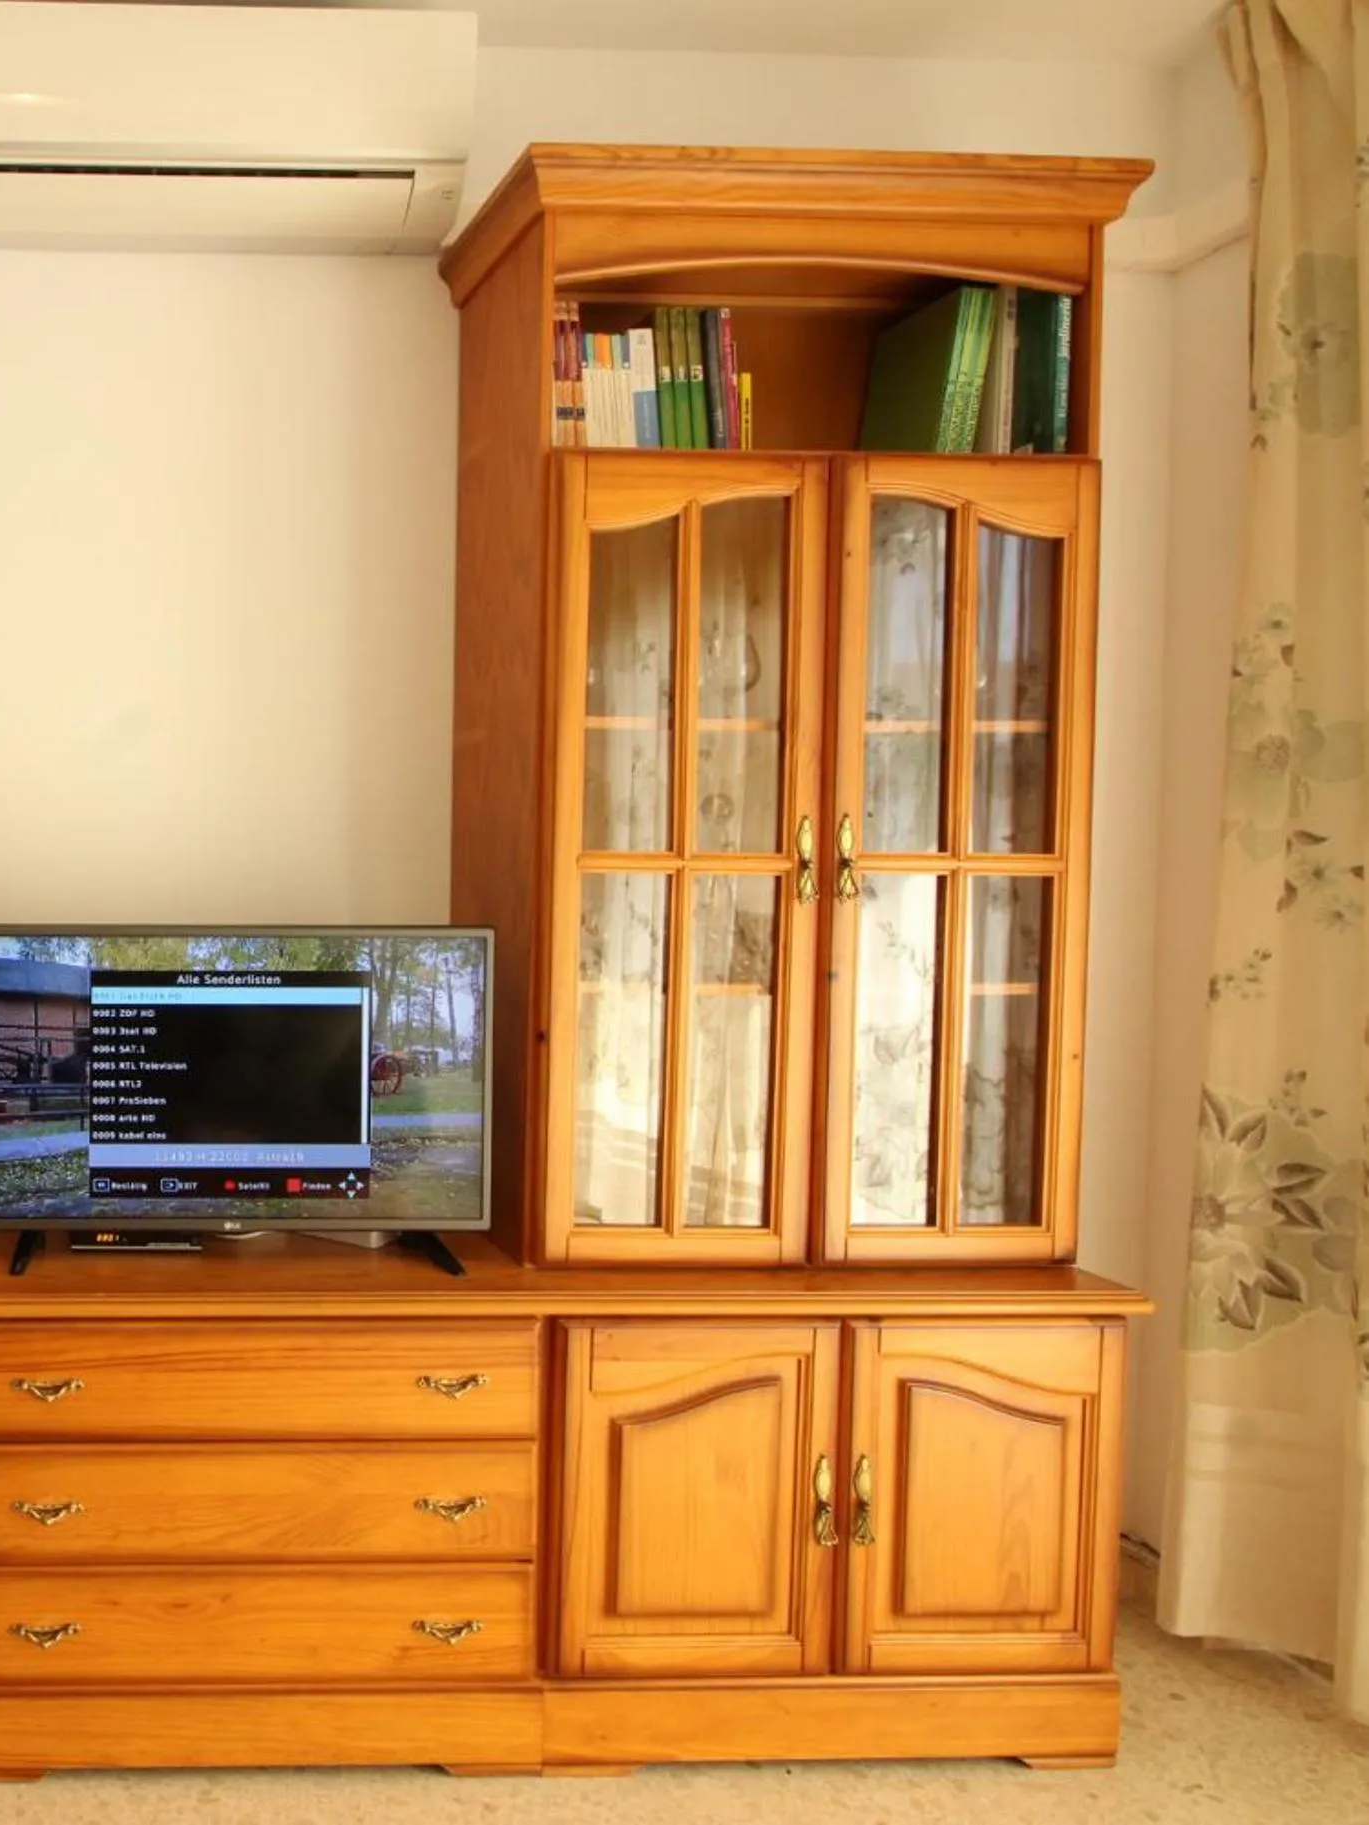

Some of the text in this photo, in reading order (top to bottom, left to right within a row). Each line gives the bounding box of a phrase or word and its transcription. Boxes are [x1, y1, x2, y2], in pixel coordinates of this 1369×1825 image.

[177, 974, 282, 985] Alle Senderlisten
[119, 1008, 138, 1018] ZDF
[140, 1008, 156, 1018] HD
[119, 1026, 140, 1036] 3sat
[142, 1026, 158, 1036] HD
[119, 1044, 145, 1054] SAT.1
[119, 1061, 136, 1071] RTL
[139, 1061, 188, 1071] Television
[119, 1079, 142, 1089] RTL2
[92, 1096, 167, 1105] 0007 ProSieben
[119, 1114, 138, 1122] arte
[141, 1114, 156, 1122] HD
[119, 1131, 145, 1140] kabel
[146, 1131, 167, 1140] eins
[178, 1182, 198, 1190] EXIT
